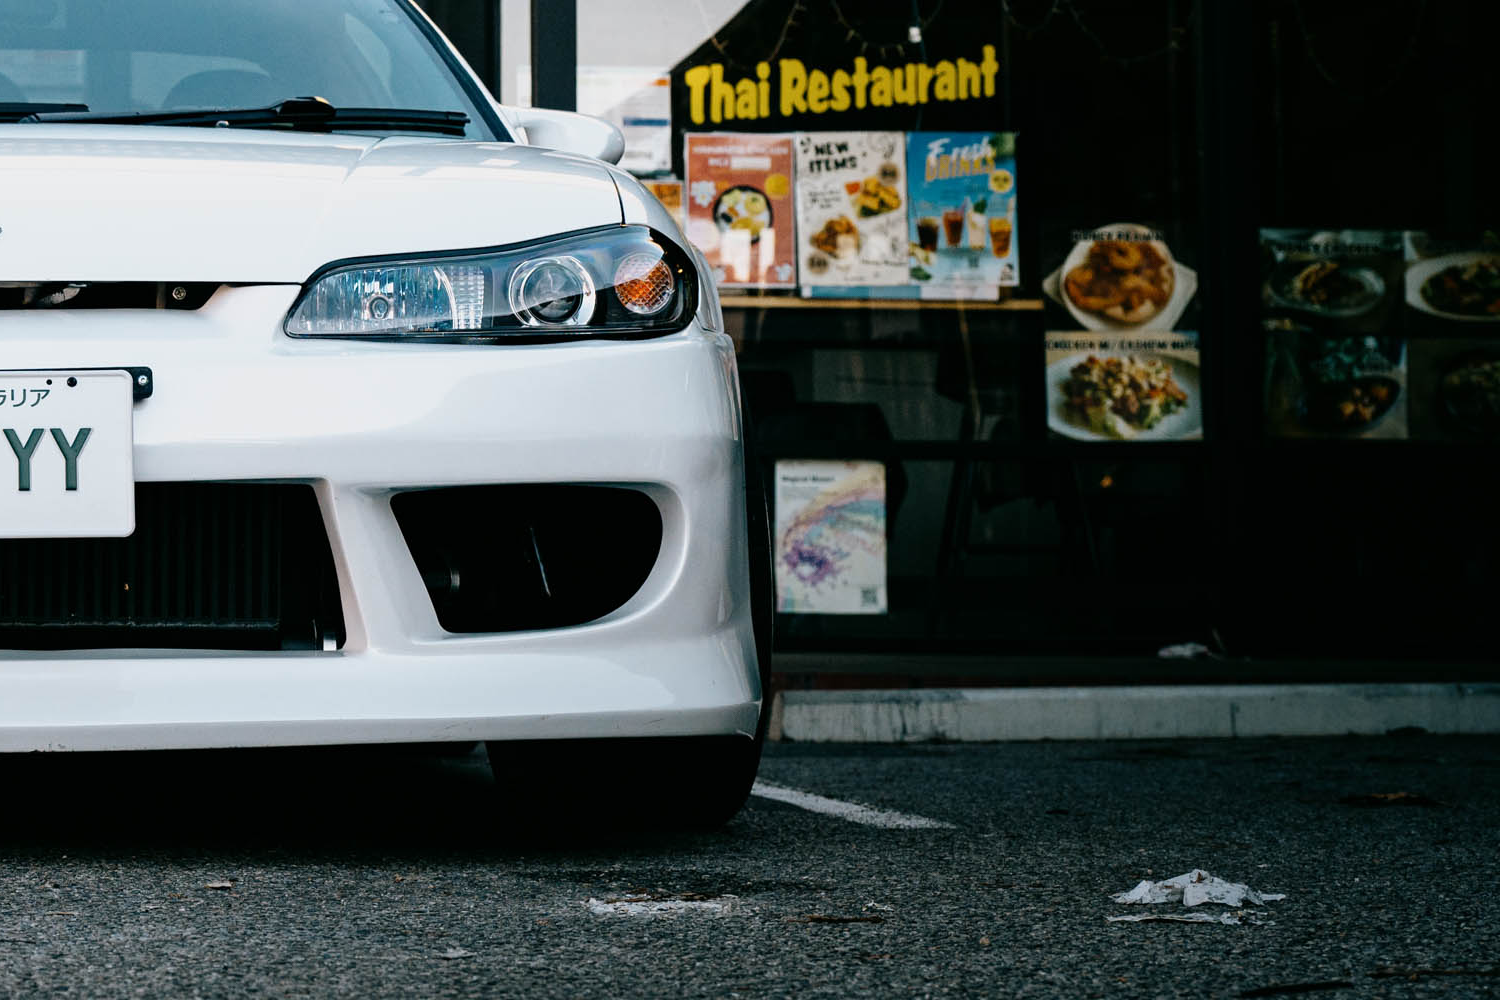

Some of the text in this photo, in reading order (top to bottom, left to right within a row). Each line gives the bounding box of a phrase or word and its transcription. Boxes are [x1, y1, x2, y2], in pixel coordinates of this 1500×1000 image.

[684, 44, 999, 125] Thai Restaurant
[814, 142, 849, 156] NEW
[809, 156, 858, 173] ITEMS
